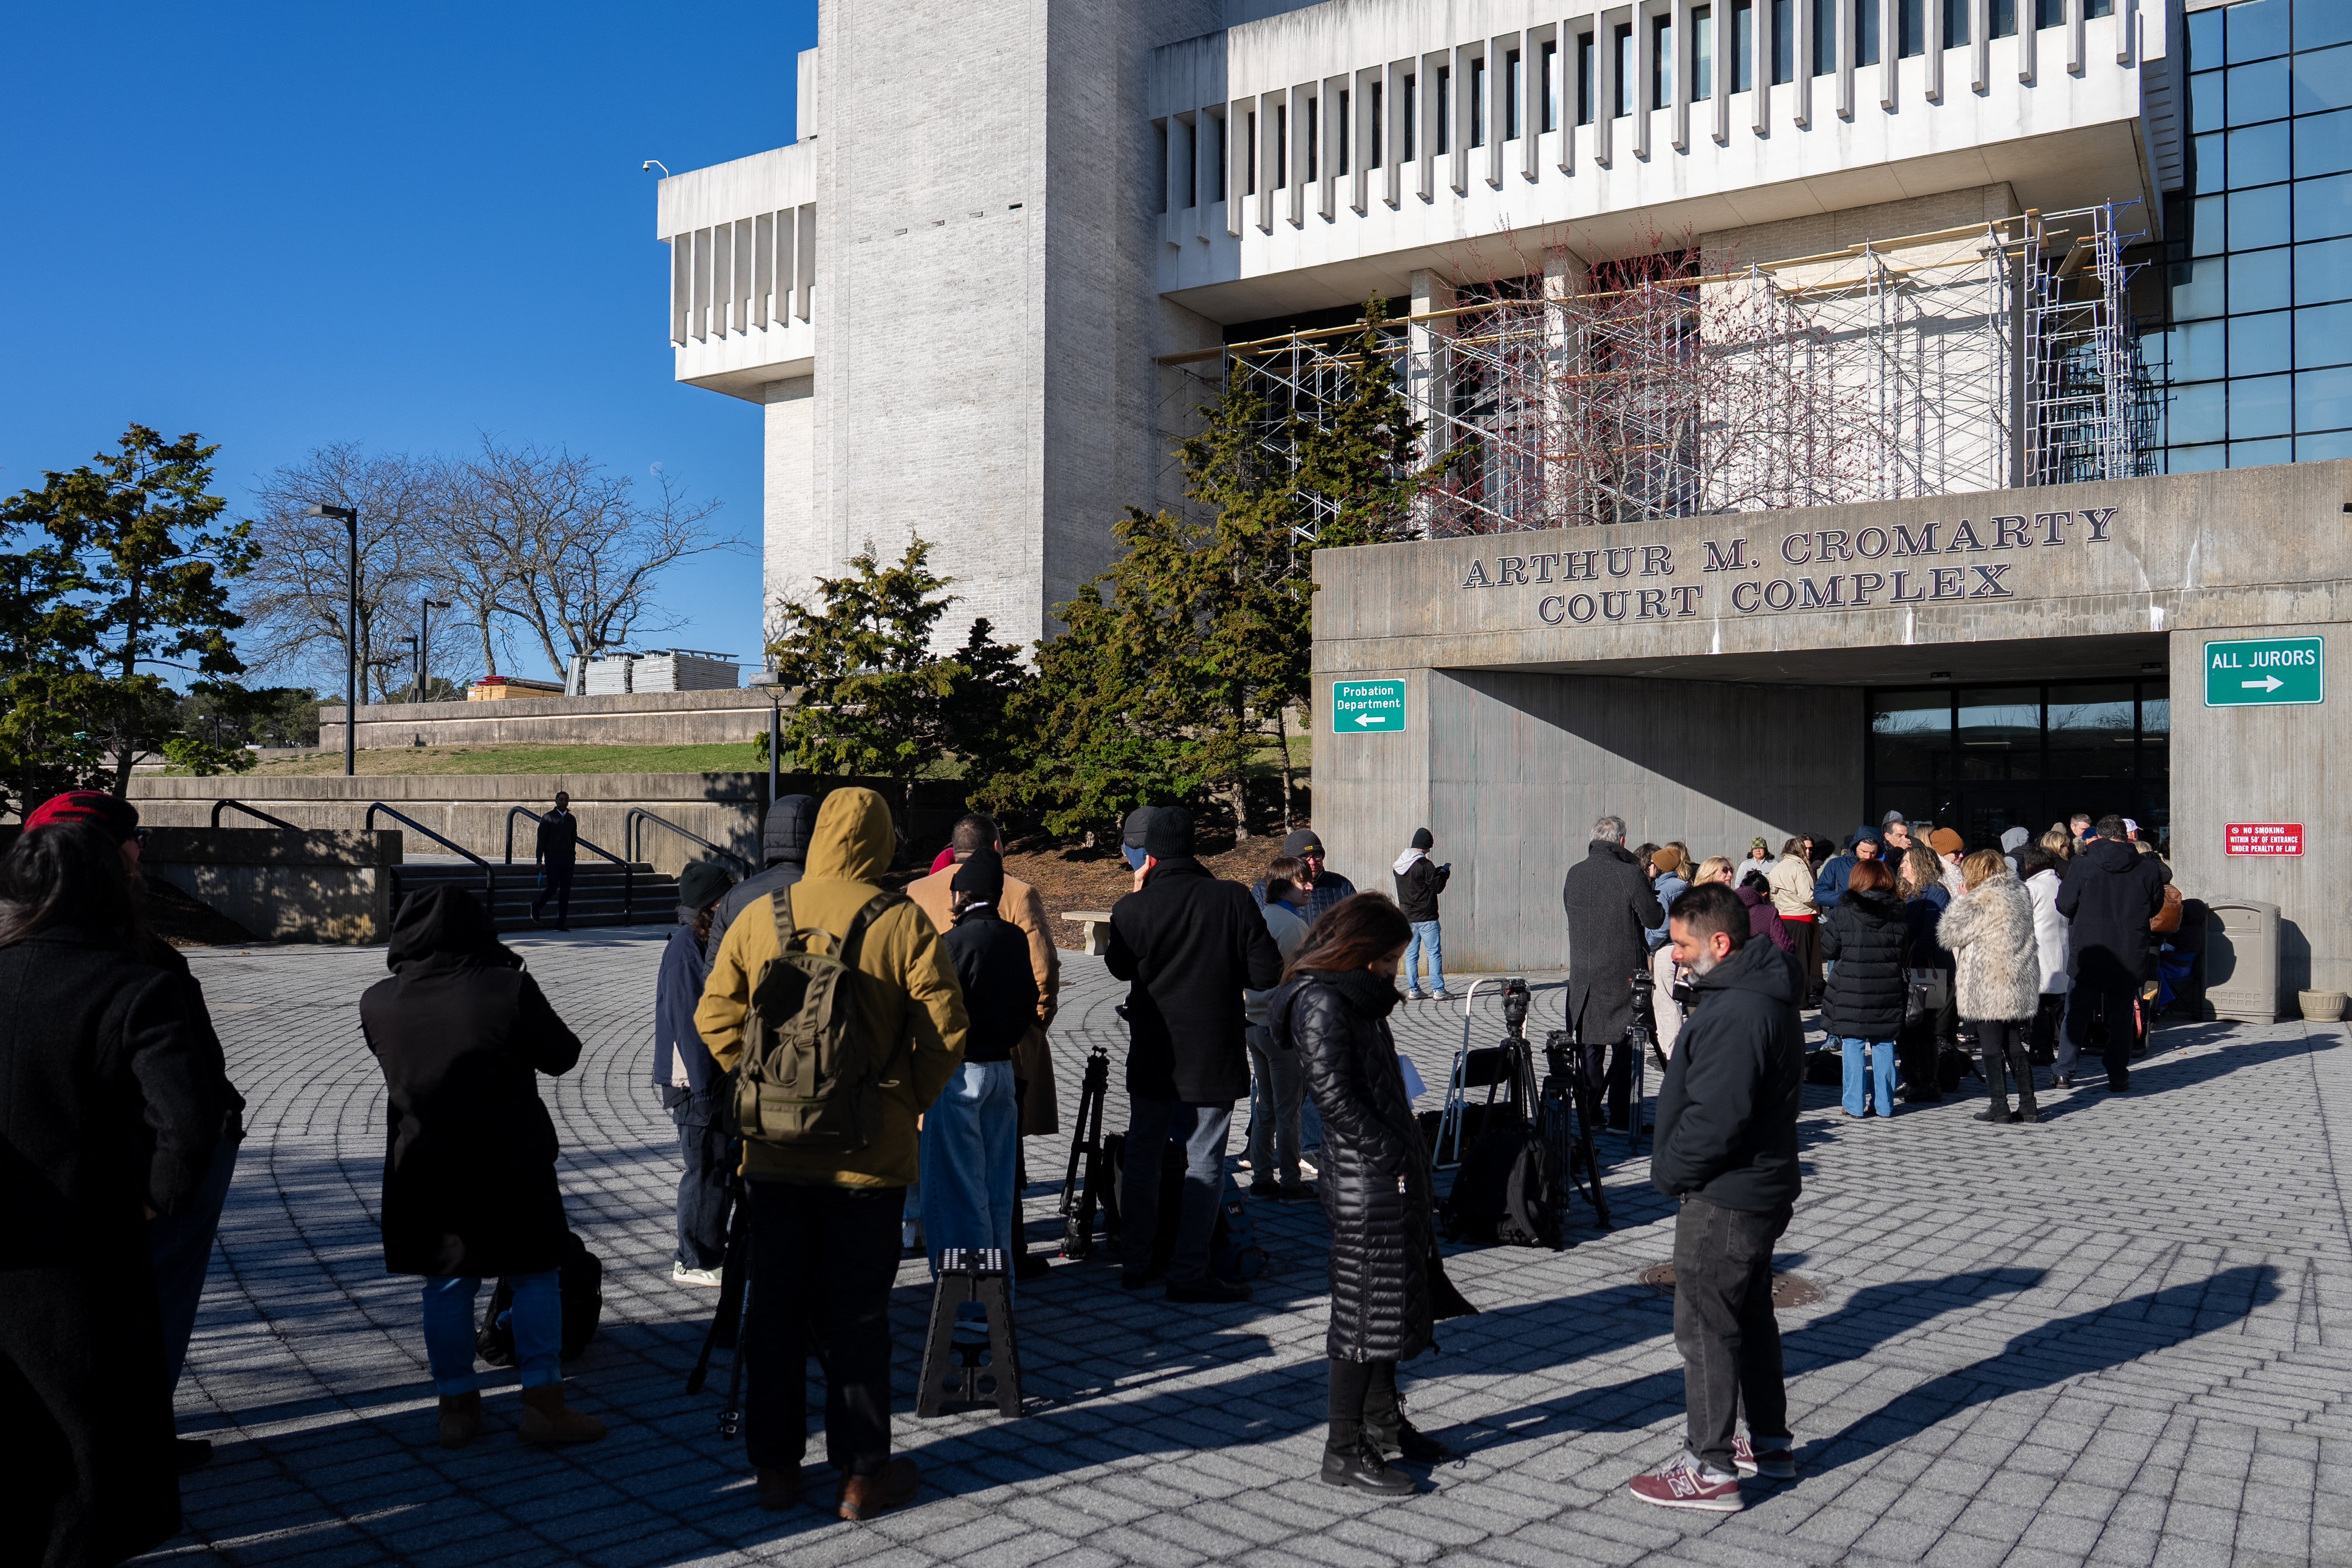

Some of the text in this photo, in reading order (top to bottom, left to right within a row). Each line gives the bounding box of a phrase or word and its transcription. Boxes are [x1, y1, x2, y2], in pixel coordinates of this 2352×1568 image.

[1462, 506, 2118, 588] ARTHUR M. CROMARTY
[1538, 563, 2013, 625] COURT COMPLEX
[2212, 650, 2315, 669] ALL JURORS
[1343, 686, 1393, 697] Probation
[1337, 698, 1401, 711] Department
[1668, 1475, 1696, 1498] N
